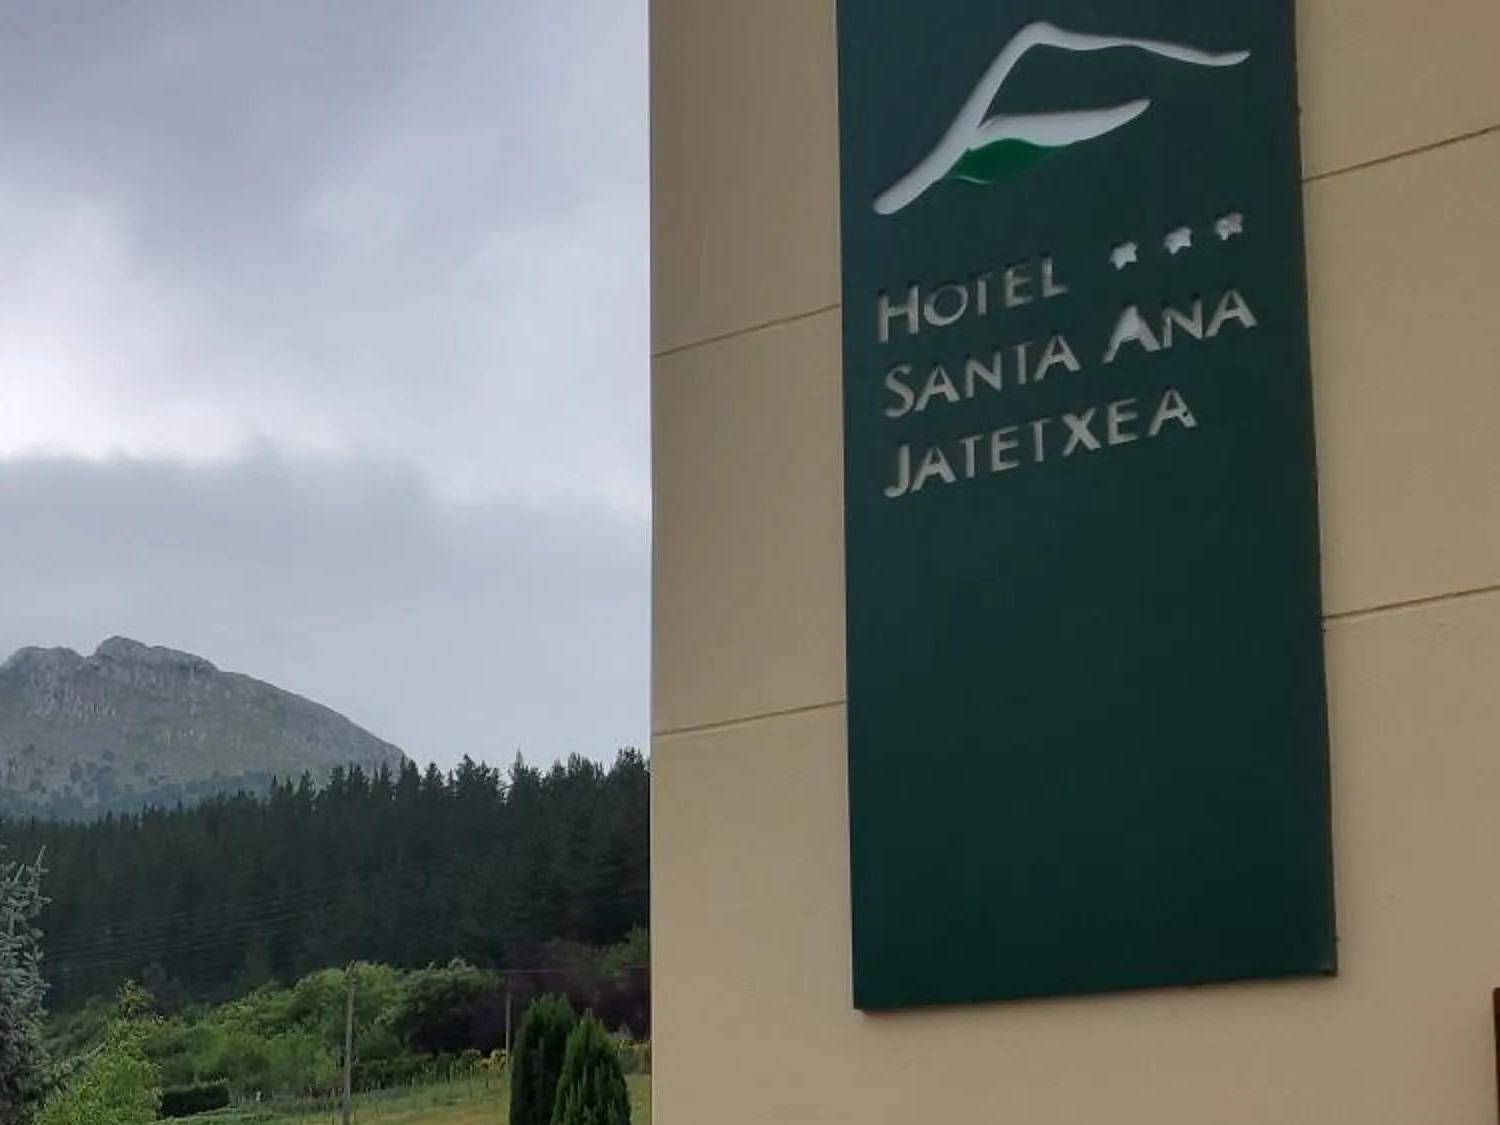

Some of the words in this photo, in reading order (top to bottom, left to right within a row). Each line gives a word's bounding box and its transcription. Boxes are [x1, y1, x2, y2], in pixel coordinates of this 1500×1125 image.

[876, 252, 1069, 344] HOTEL
[883, 333, 1082, 419] SANTA
[1101, 287, 1259, 364] ANA
[883, 388, 1199, 499] JATETXEA
